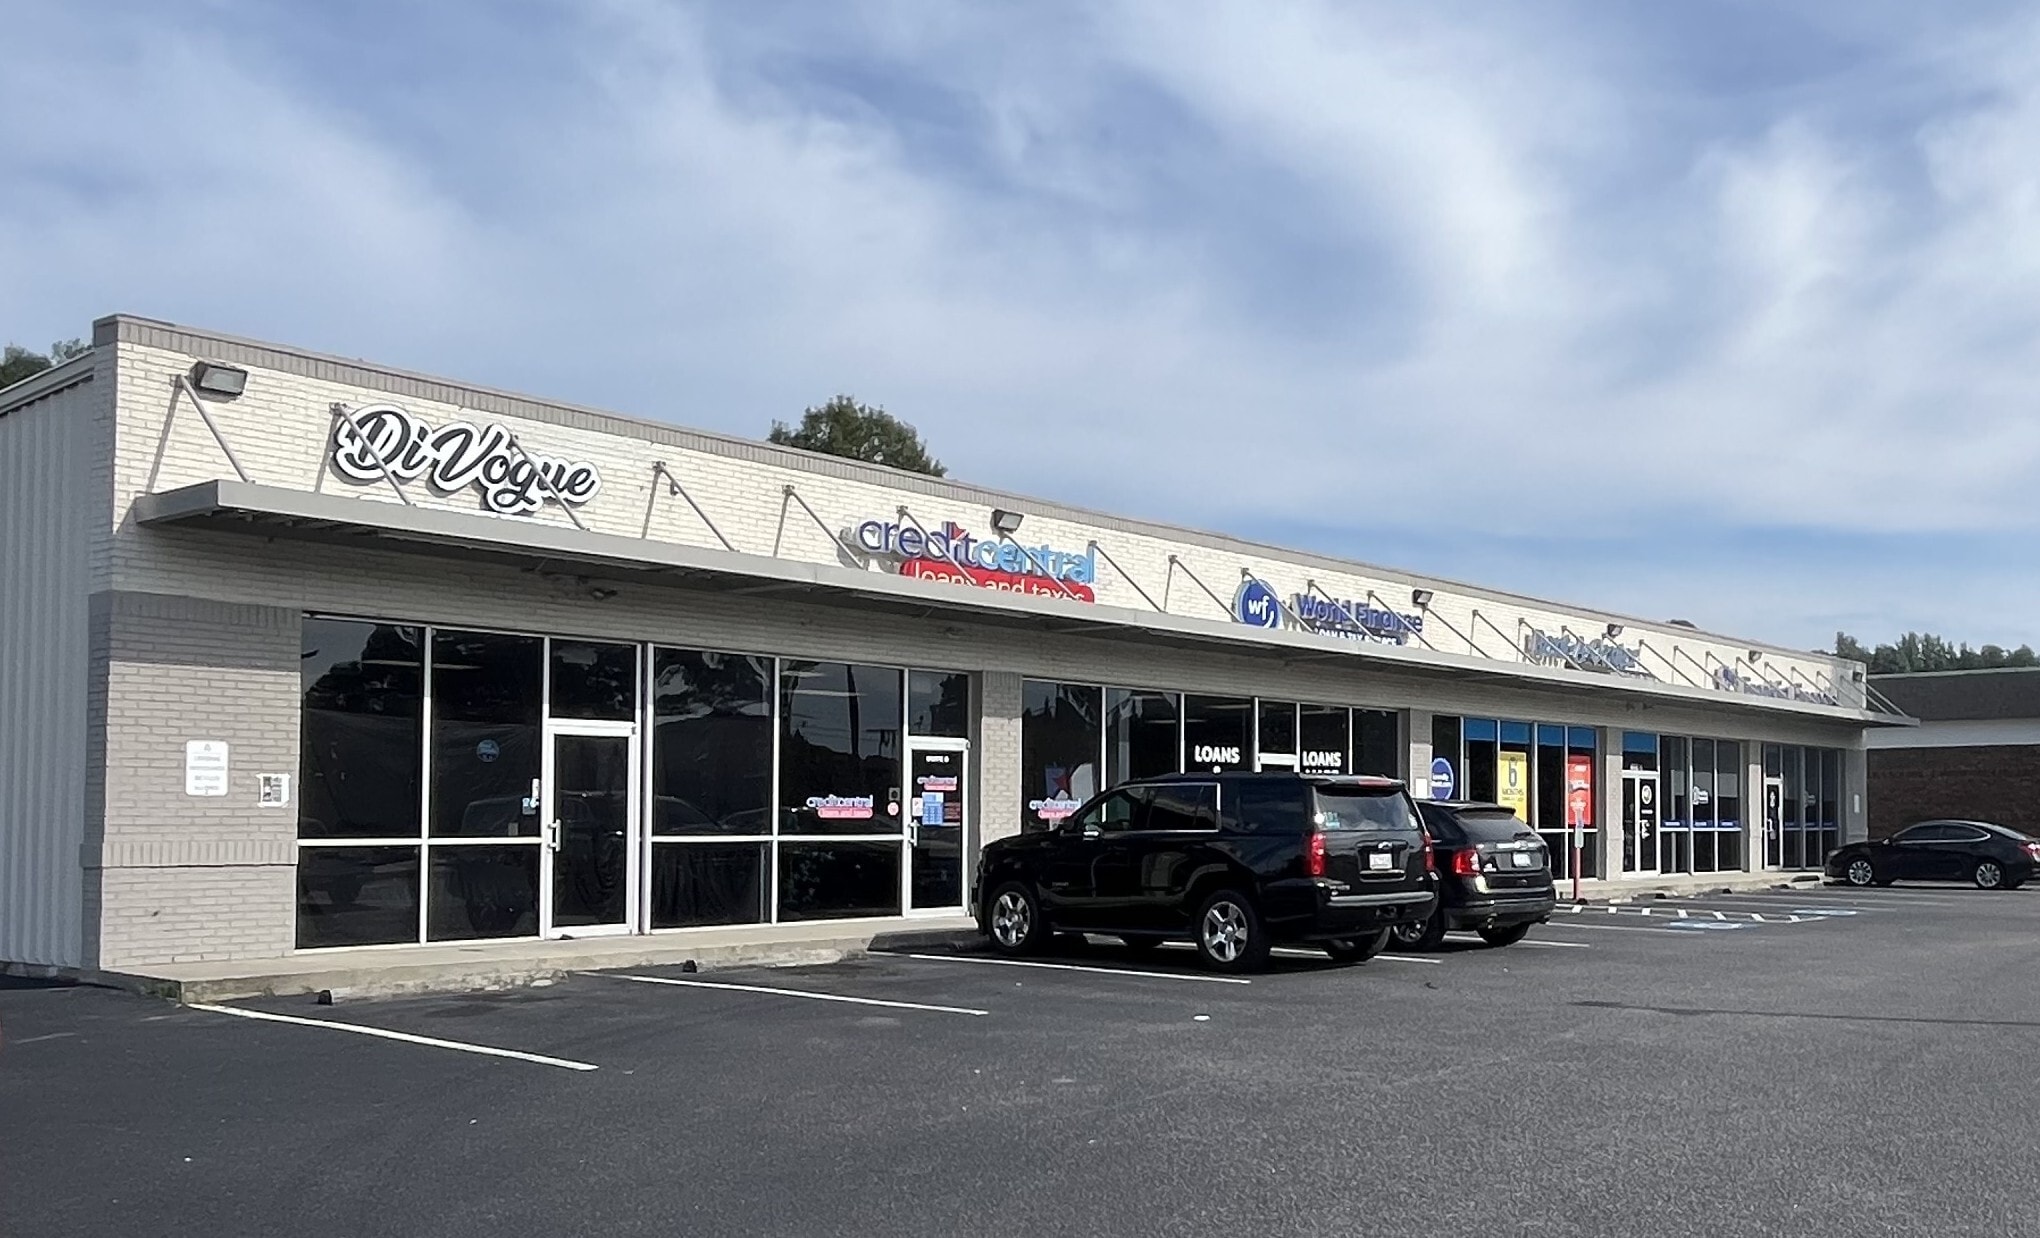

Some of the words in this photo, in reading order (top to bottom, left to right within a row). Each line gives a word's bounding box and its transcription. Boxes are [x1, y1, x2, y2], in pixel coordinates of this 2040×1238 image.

[1248, 595, 1270, 621] wf
[1194, 744, 1240, 764] LOANS
[1302, 751, 1342, 767] LOANS
